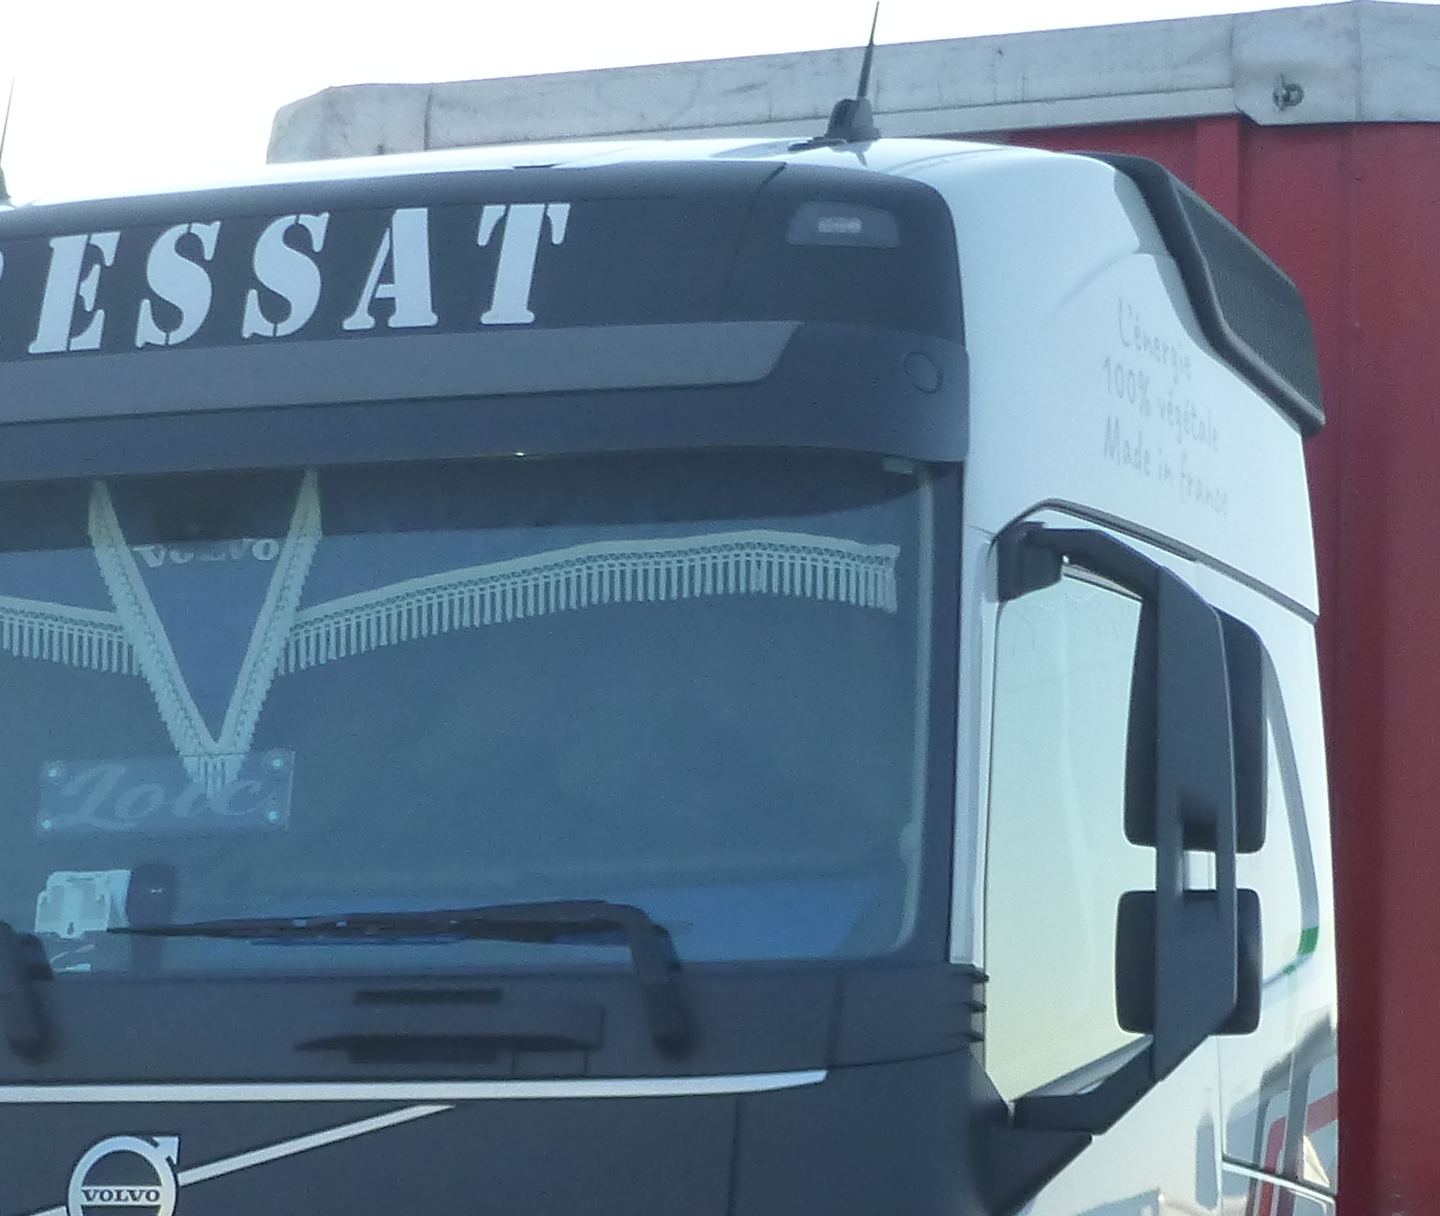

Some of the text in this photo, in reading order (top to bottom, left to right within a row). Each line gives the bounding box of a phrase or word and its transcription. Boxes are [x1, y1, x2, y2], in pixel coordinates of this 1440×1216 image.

[1102, 355, 1151, 418] 100%
[1103, 414, 1151, 476] Made
[80, 1189, 161, 1202] VOLVO
